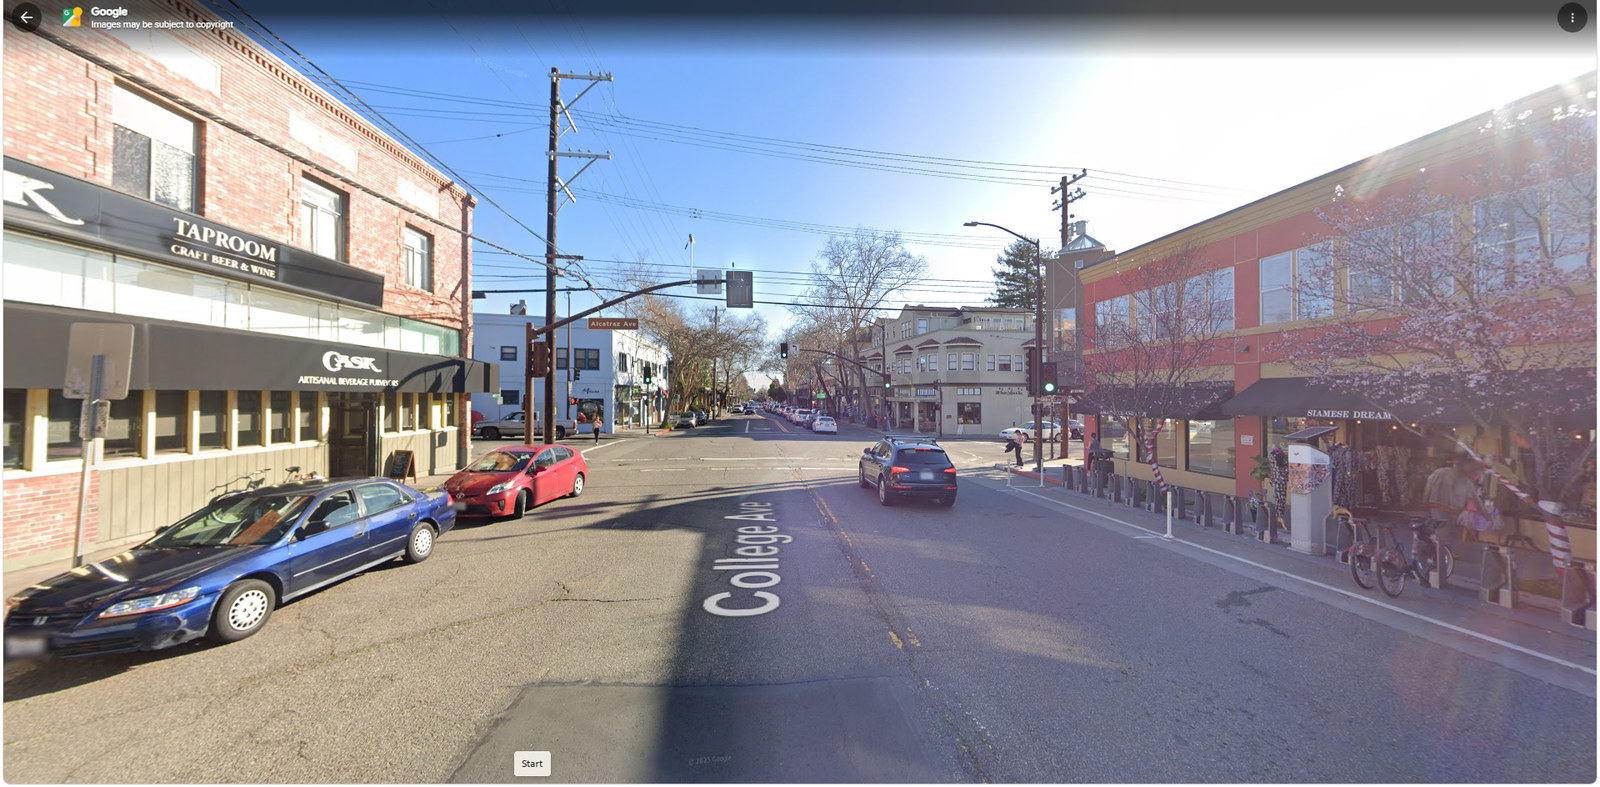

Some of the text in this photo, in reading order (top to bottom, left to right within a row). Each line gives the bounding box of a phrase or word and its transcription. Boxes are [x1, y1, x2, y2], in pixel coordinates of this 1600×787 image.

[173, 217, 276, 262] TAPROOM
[170, 244, 276, 279] CRAFT BEER & WINE
[322, 350, 382, 373] CASK
[298, 375, 399, 387] ARTISANAL BEVERAGE PURVEYORS
[1307, 409, 1392, 420] SIAMESE DREAM
